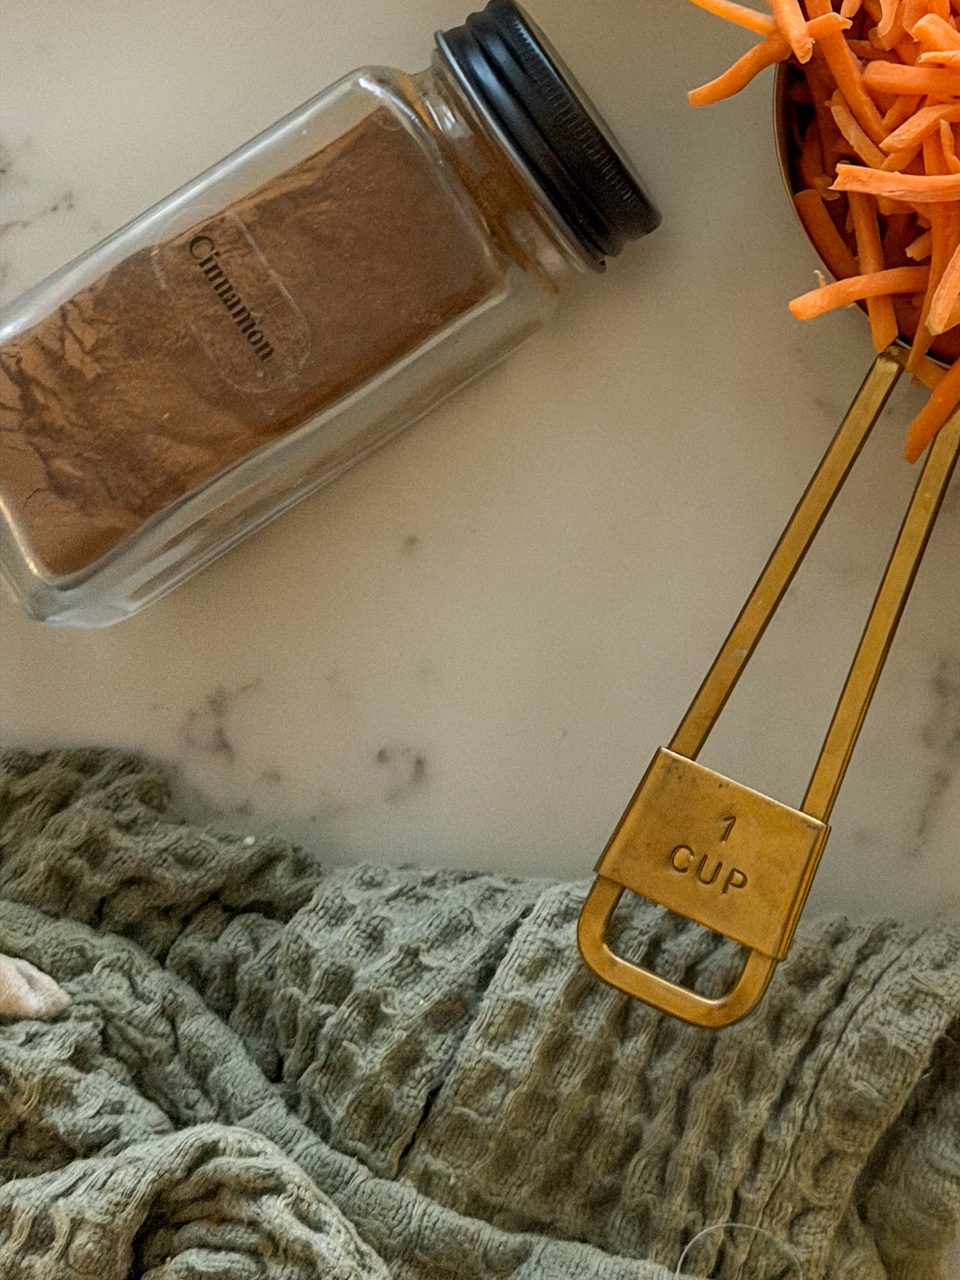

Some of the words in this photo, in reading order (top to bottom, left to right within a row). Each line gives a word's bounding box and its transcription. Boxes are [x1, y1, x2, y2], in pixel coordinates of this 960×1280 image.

[188, 234, 275, 361] Cinnamon
[720, 815, 737, 843] 1
[670, 844, 749, 894] CUP
